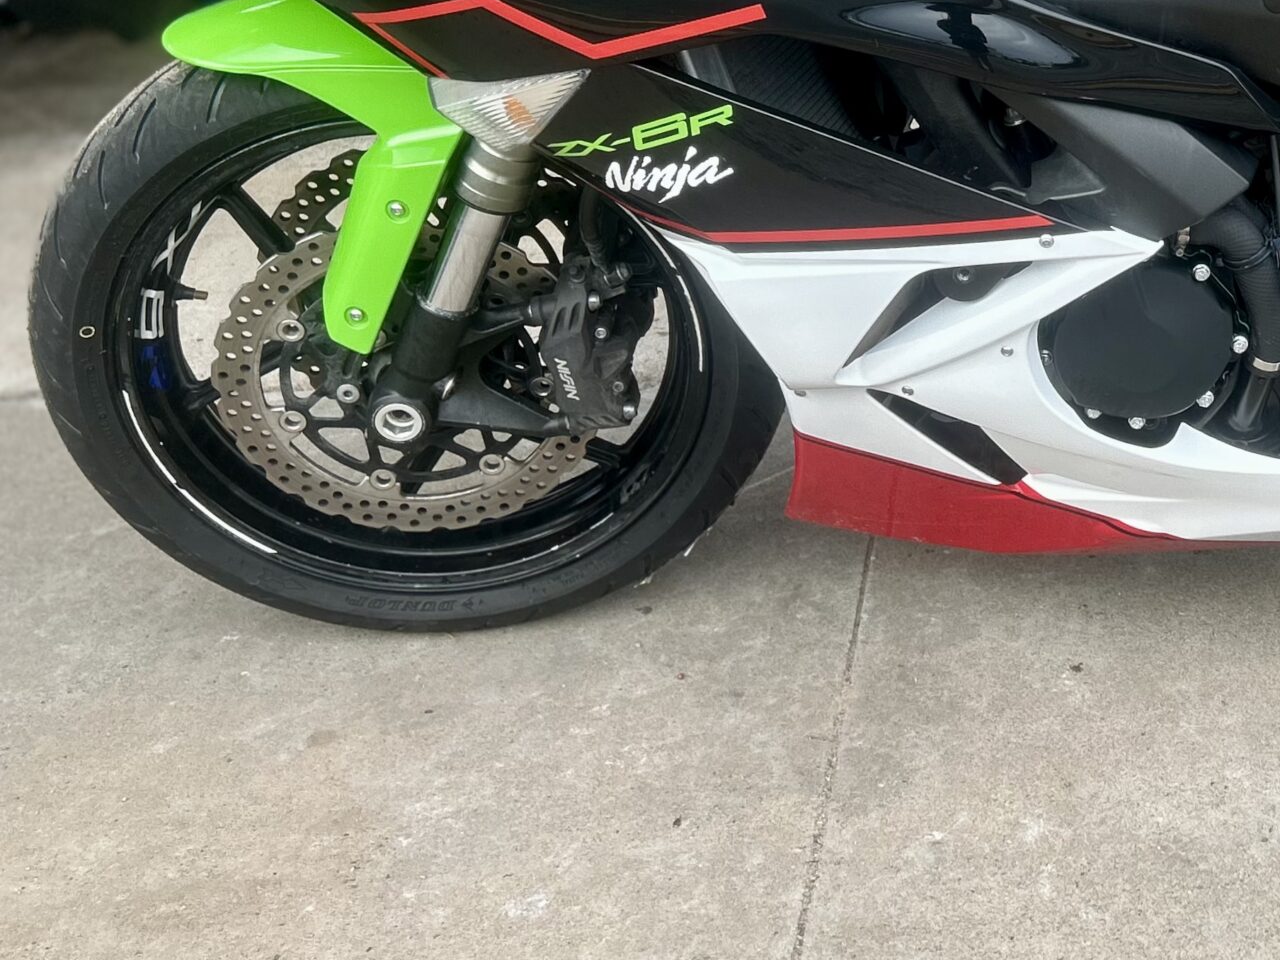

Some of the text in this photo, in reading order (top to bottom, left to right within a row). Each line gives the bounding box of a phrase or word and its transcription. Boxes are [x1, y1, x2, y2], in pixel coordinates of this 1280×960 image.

[547, 104, 734, 157] ZX-6R
[605, 145, 735, 204] Ninja
[345, 595, 457, 613] DUNLOP
